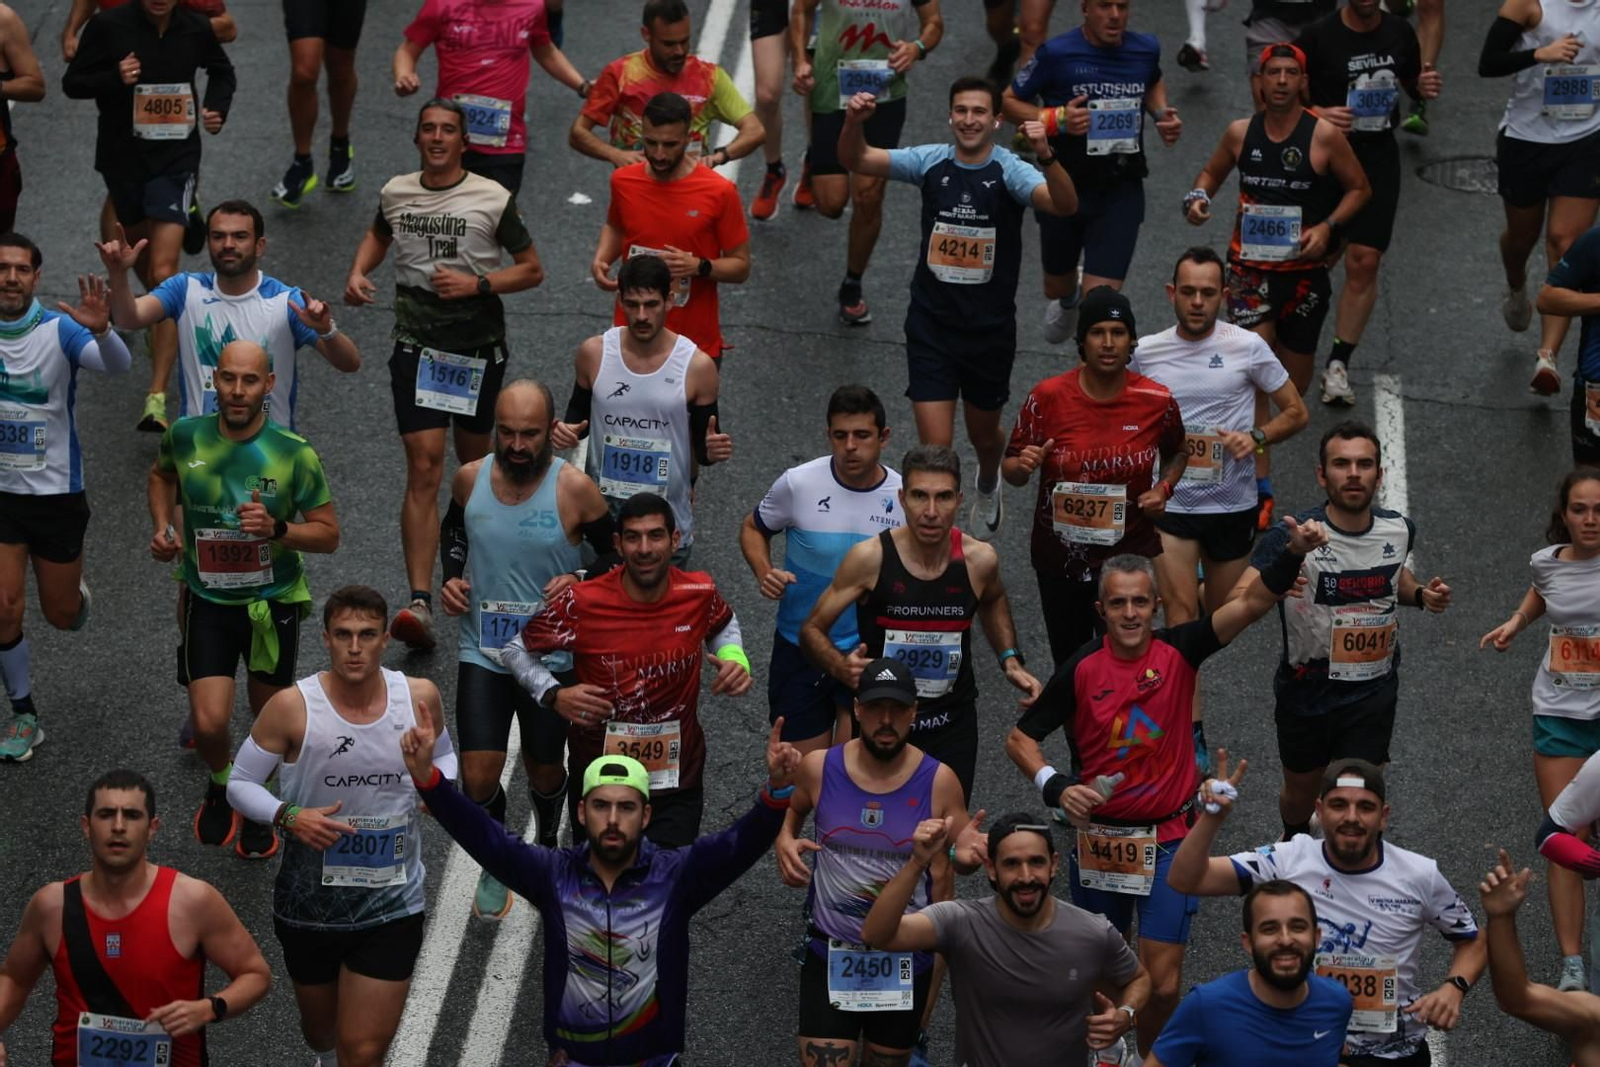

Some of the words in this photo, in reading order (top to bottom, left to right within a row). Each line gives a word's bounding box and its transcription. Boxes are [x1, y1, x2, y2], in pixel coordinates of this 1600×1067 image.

[1347, 54, 1396, 72] SEVILLA
[1552, 79, 1588, 96] 2988
[144, 98, 183, 115] 4805
[467, 108, 496, 127] 924
[1097, 113, 1133, 131] 2269
[1248, 219, 1286, 236] 2466
[427, 235, 458, 259] Trail
[938, 239, 980, 259] 4214
[428, 364, 467, 387] 1516
[604, 414, 670, 430] CAPACITY
[1186, 438, 1207, 457] 69
[611, 451, 654, 474] 1918
[1063, 497, 1108, 518] 6237
[519, 509, 558, 528] 25
[869, 514, 901, 528] ATENEA
[208, 544, 254, 562] 1392
[886, 605, 965, 616] PRORUNNERS
[490, 616, 520, 637] 171
[1343, 630, 1387, 652] 6041
[919, 711, 950, 731] MAX
[617, 740, 664, 761] 3549
[324, 772, 404, 788] CAPACITY
[338, 833, 390, 856] 2807
[1090, 840, 1138, 863] 4419
[841, 955, 892, 978] 2450
[90, 1035, 148, 1062] 2292
